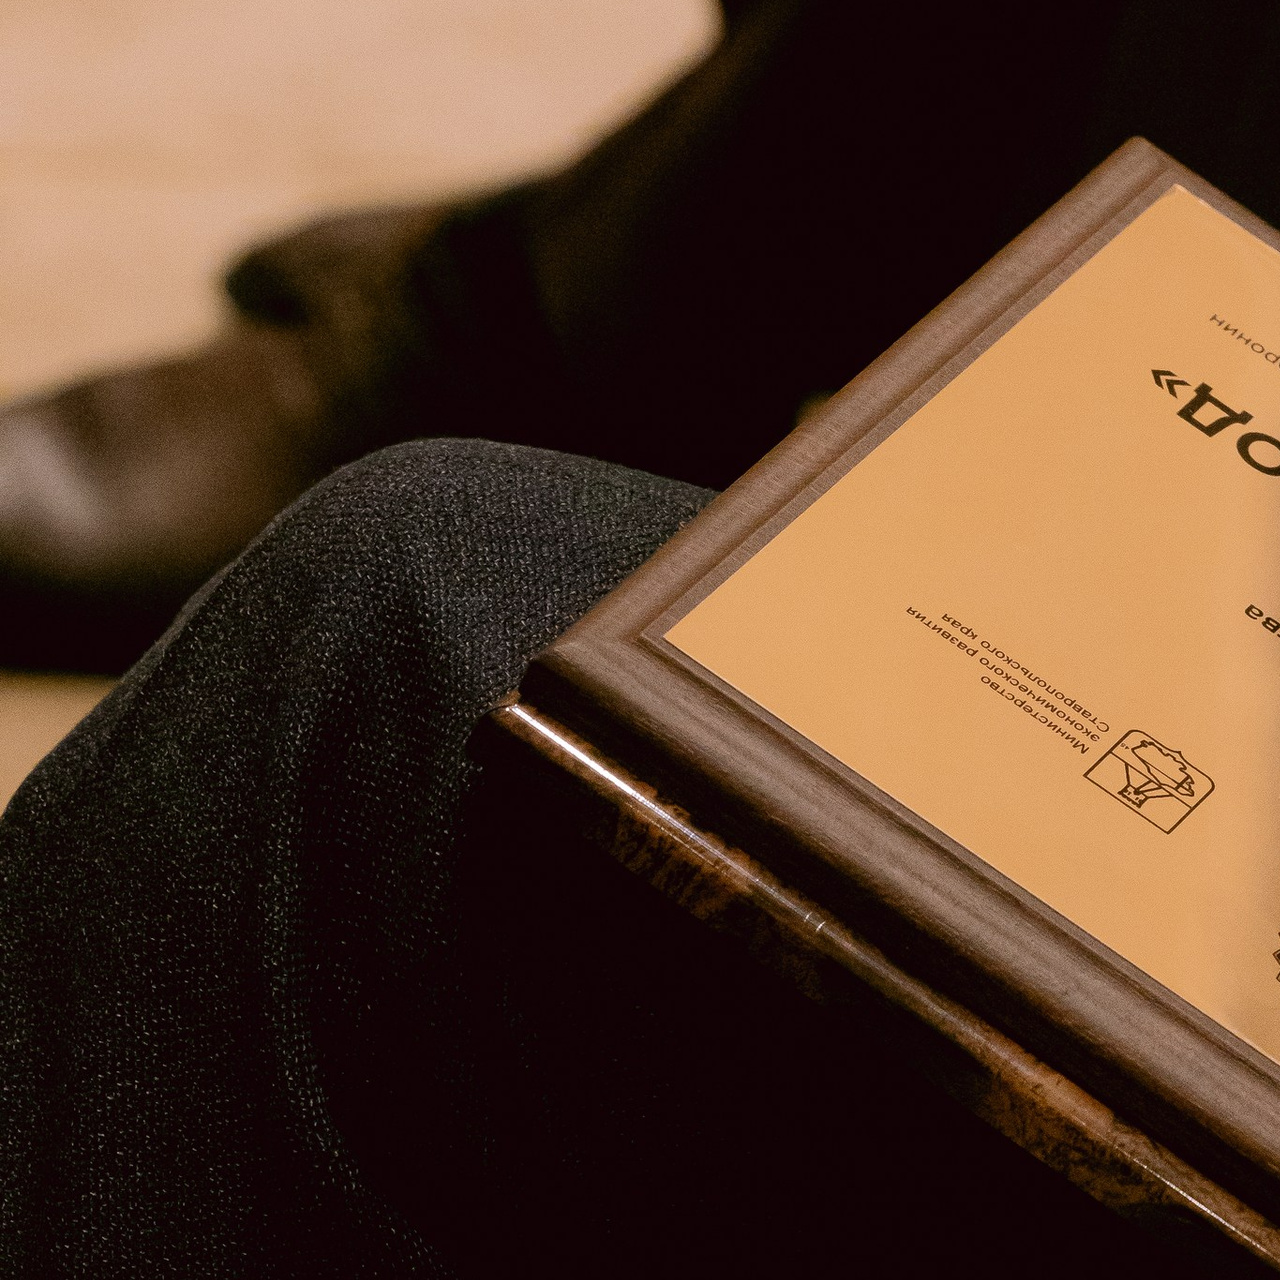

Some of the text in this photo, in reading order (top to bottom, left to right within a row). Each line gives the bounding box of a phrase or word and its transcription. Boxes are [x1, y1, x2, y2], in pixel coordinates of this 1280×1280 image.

[907, 607, 1099, 741] экономического развития
[942, 614, 1109, 732] Ставропольского края
[981, 676, 1089, 754] Министерство
